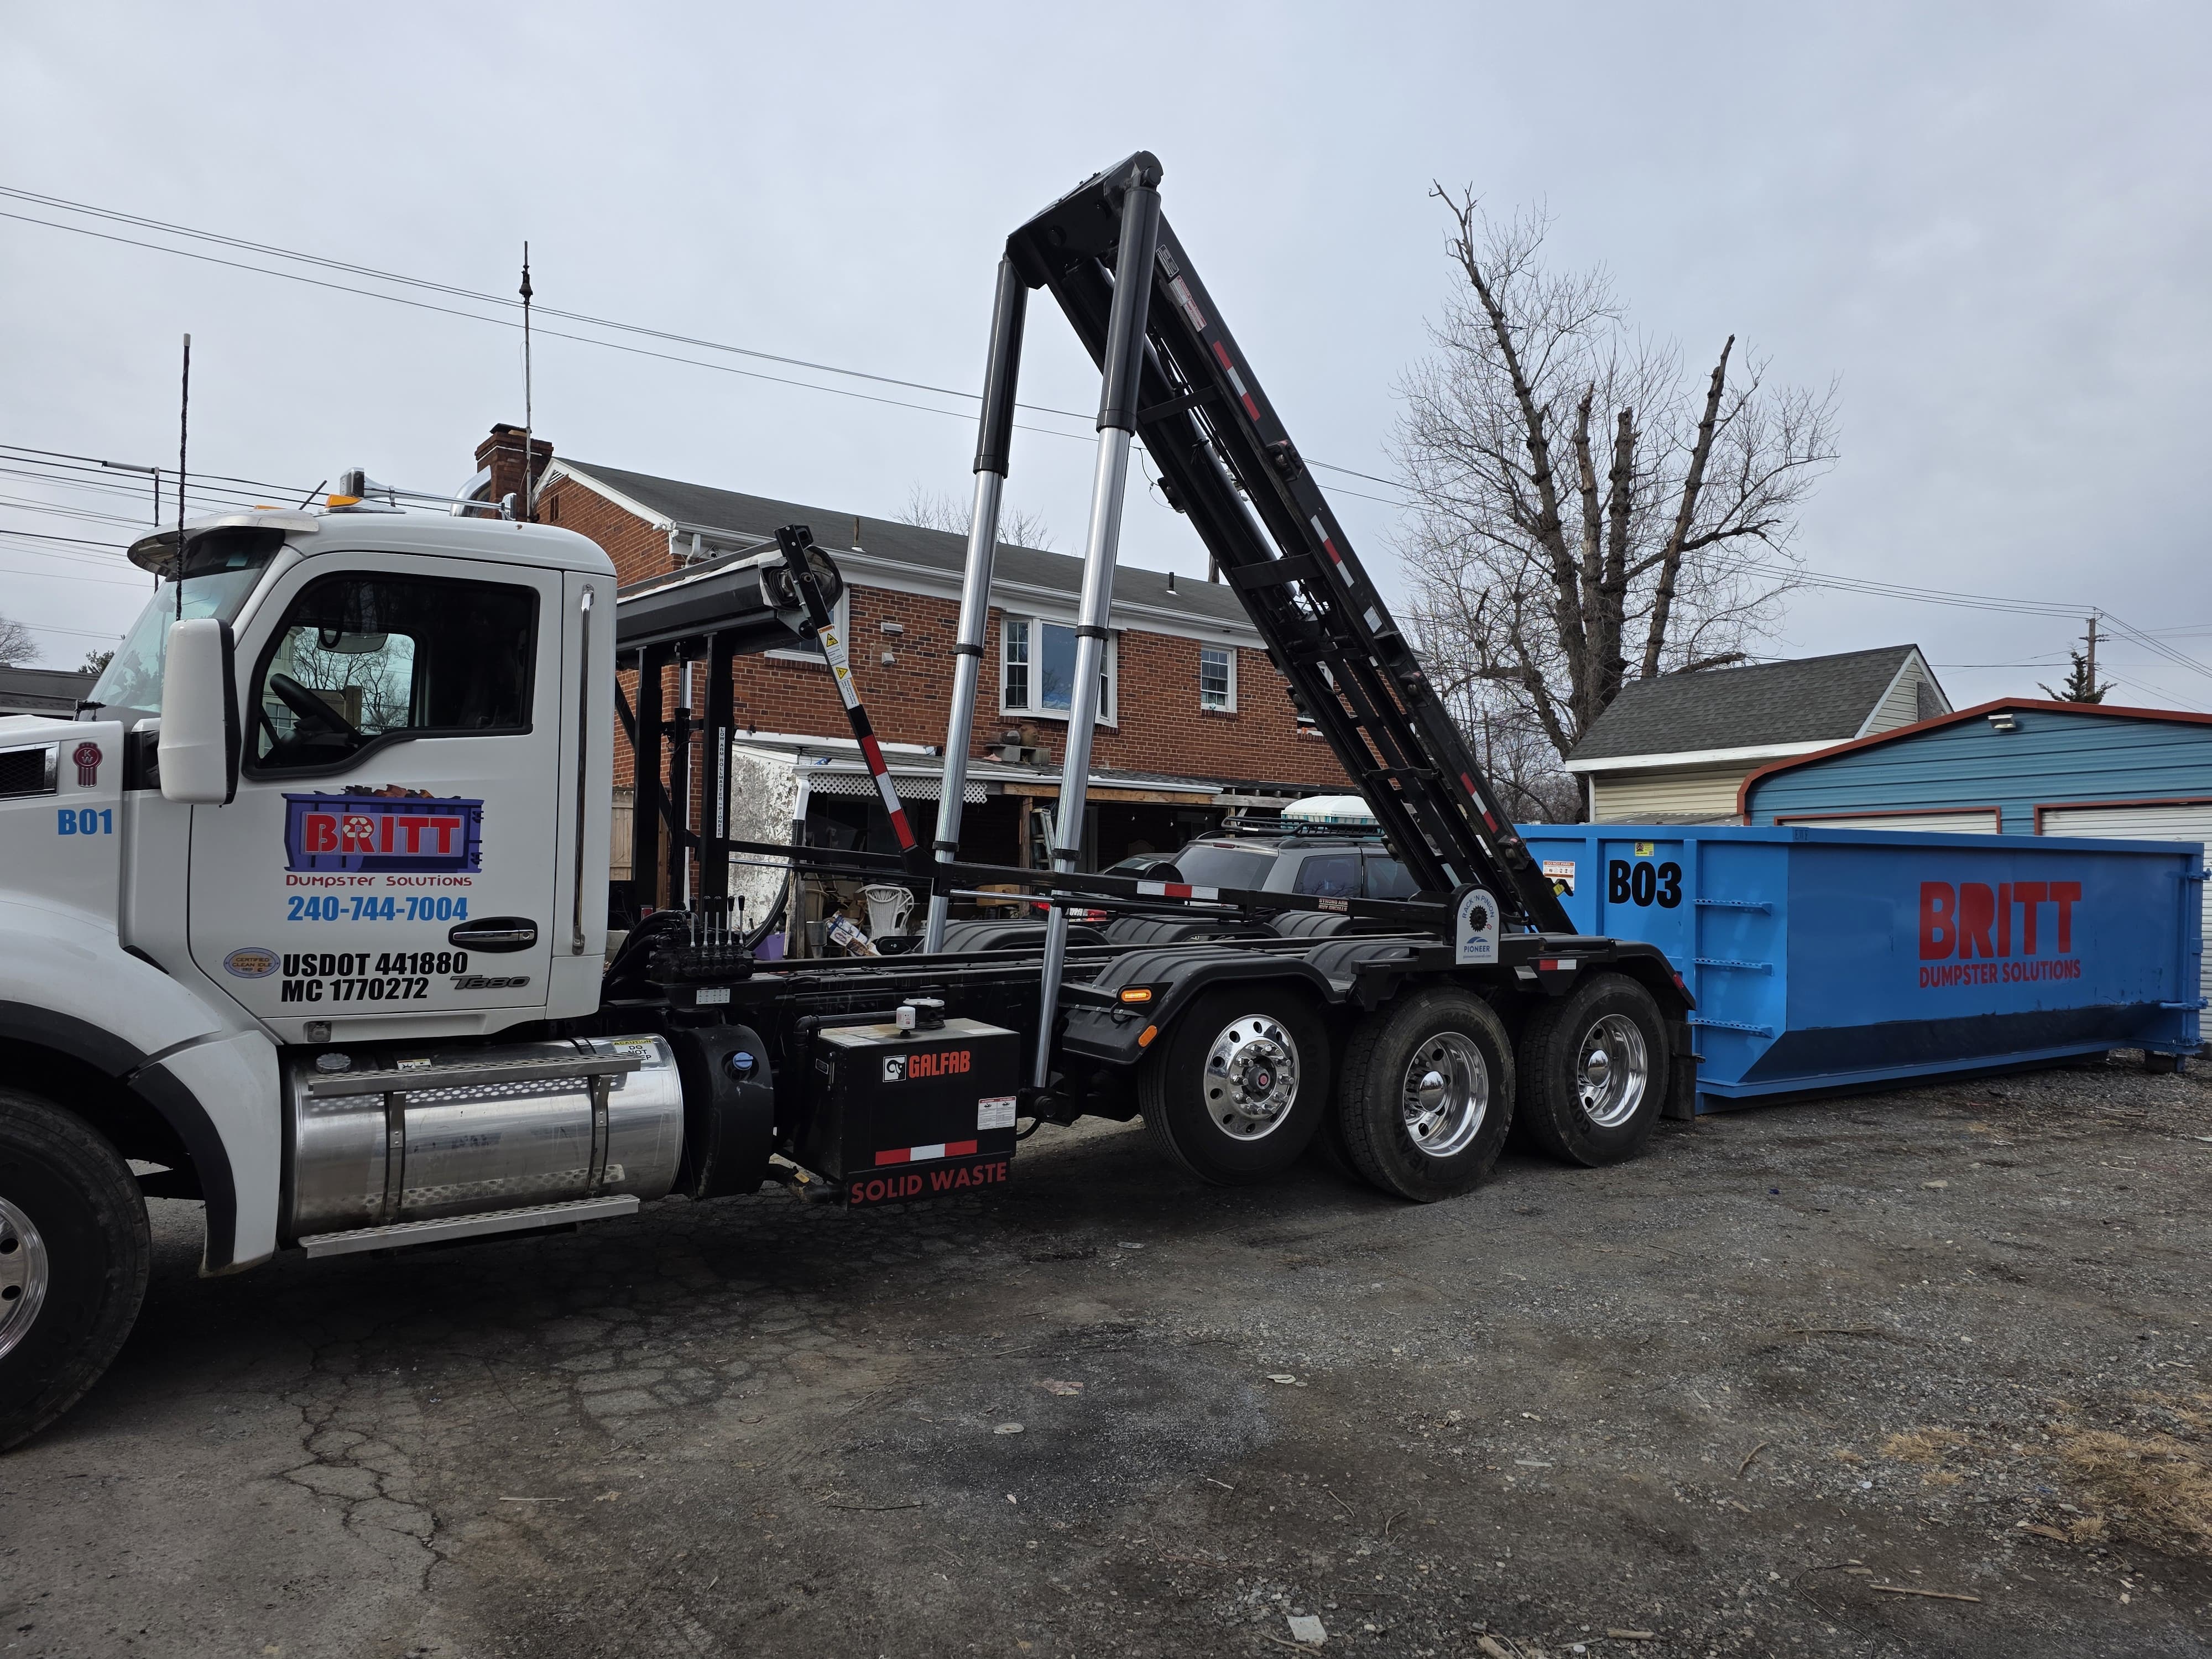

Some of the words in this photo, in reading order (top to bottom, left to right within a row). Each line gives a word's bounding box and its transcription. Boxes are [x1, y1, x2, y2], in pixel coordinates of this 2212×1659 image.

[58, 808, 112, 835] B01
[305, 813, 461, 854] BRITT
[1609, 859, 1682, 909] B03
[287, 896, 468, 921] 240-744-7004
[1462, 898, 1474, 919] RACK
[1481, 895, 1495, 918] PINION
[1919, 881, 2081, 960] BRITT
[283, 953, 371, 977] USDOT
[375, 952, 468, 975] 441880
[1919, 963, 1998, 988] DUMPSTER
[2002, 958, 2081, 983] SOLUTIONS
[281, 979, 323, 1002] MC
[329, 977, 430, 1001] 1770272
[450, 975, 530, 990] T880
[909, 1051, 971, 1078] GALFAB
[851, 1175, 923, 1204] SOLID
[930, 1162, 1007, 1191] WASTE
